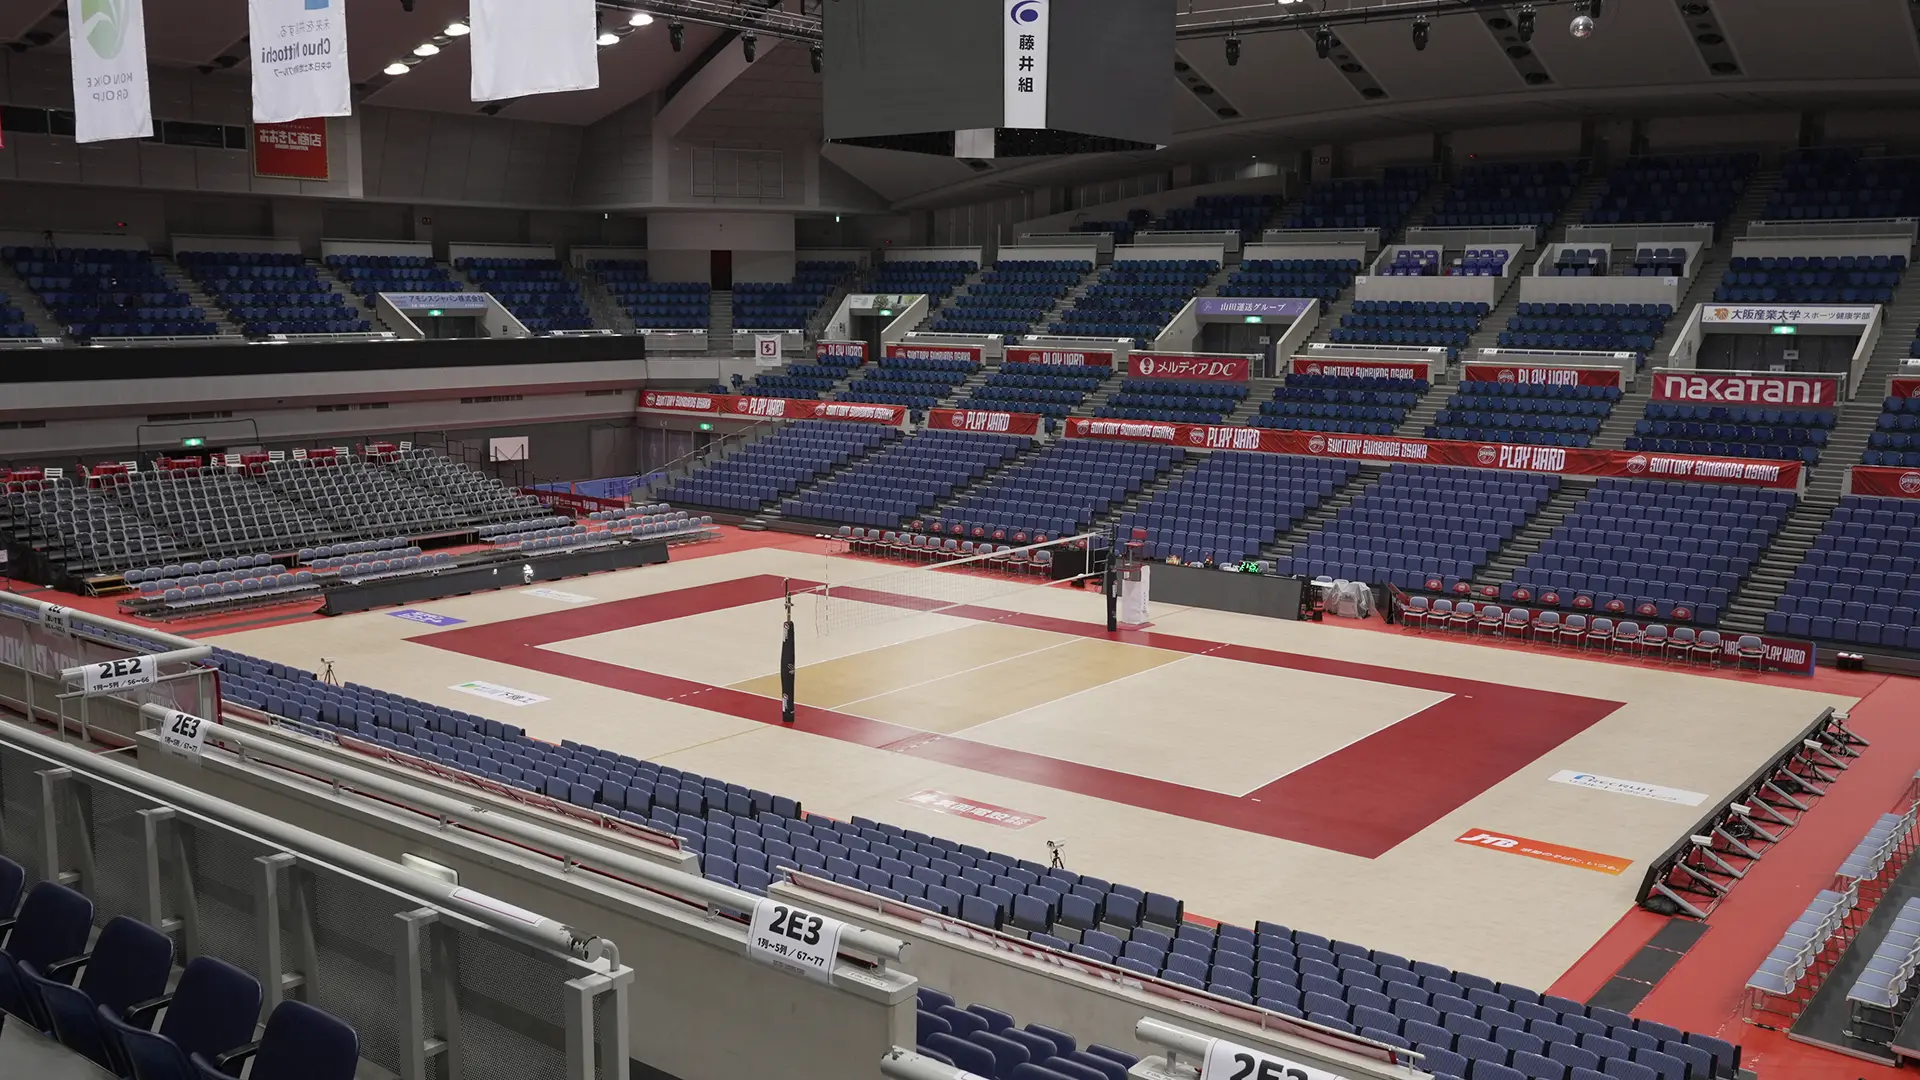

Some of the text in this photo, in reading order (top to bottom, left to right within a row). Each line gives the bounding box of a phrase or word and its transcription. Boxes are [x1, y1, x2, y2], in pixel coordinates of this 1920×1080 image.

[1018, 34, 1034, 92] 藤井組
[259, 128, 322, 148] おおきに商店
[1220, 303, 1287, 312] 山田運送グループ
[1731, 309, 1870, 320] 大阪産業大学 スポーツ健康学部
[1157, 362, 1237, 376] メルディアDC
[749, 397, 766, 415] PLAY
[966, 411, 1010, 431] PLAY HARD
[1090, 422, 1176, 440] SUNTORY SUNBIRDS OSAKA
[1206, 427, 1260, 449] PLAY HARD
[1327, 438, 1428, 459] SUNTORY SUNBIRDS OSAKA
[1499, 445, 1566, 471] PLAY HARD
[1650, 457, 1780, 482] SUNTORY SUNBIRDS OSAKA
[1761, 644, 1806, 664] PLAY HARD
[98, 658, 142, 680] 2E2
[171, 714, 201, 739] 2E3
[1460, 833, 1519, 848] JTB
[768, 905, 824, 946] 2E3
